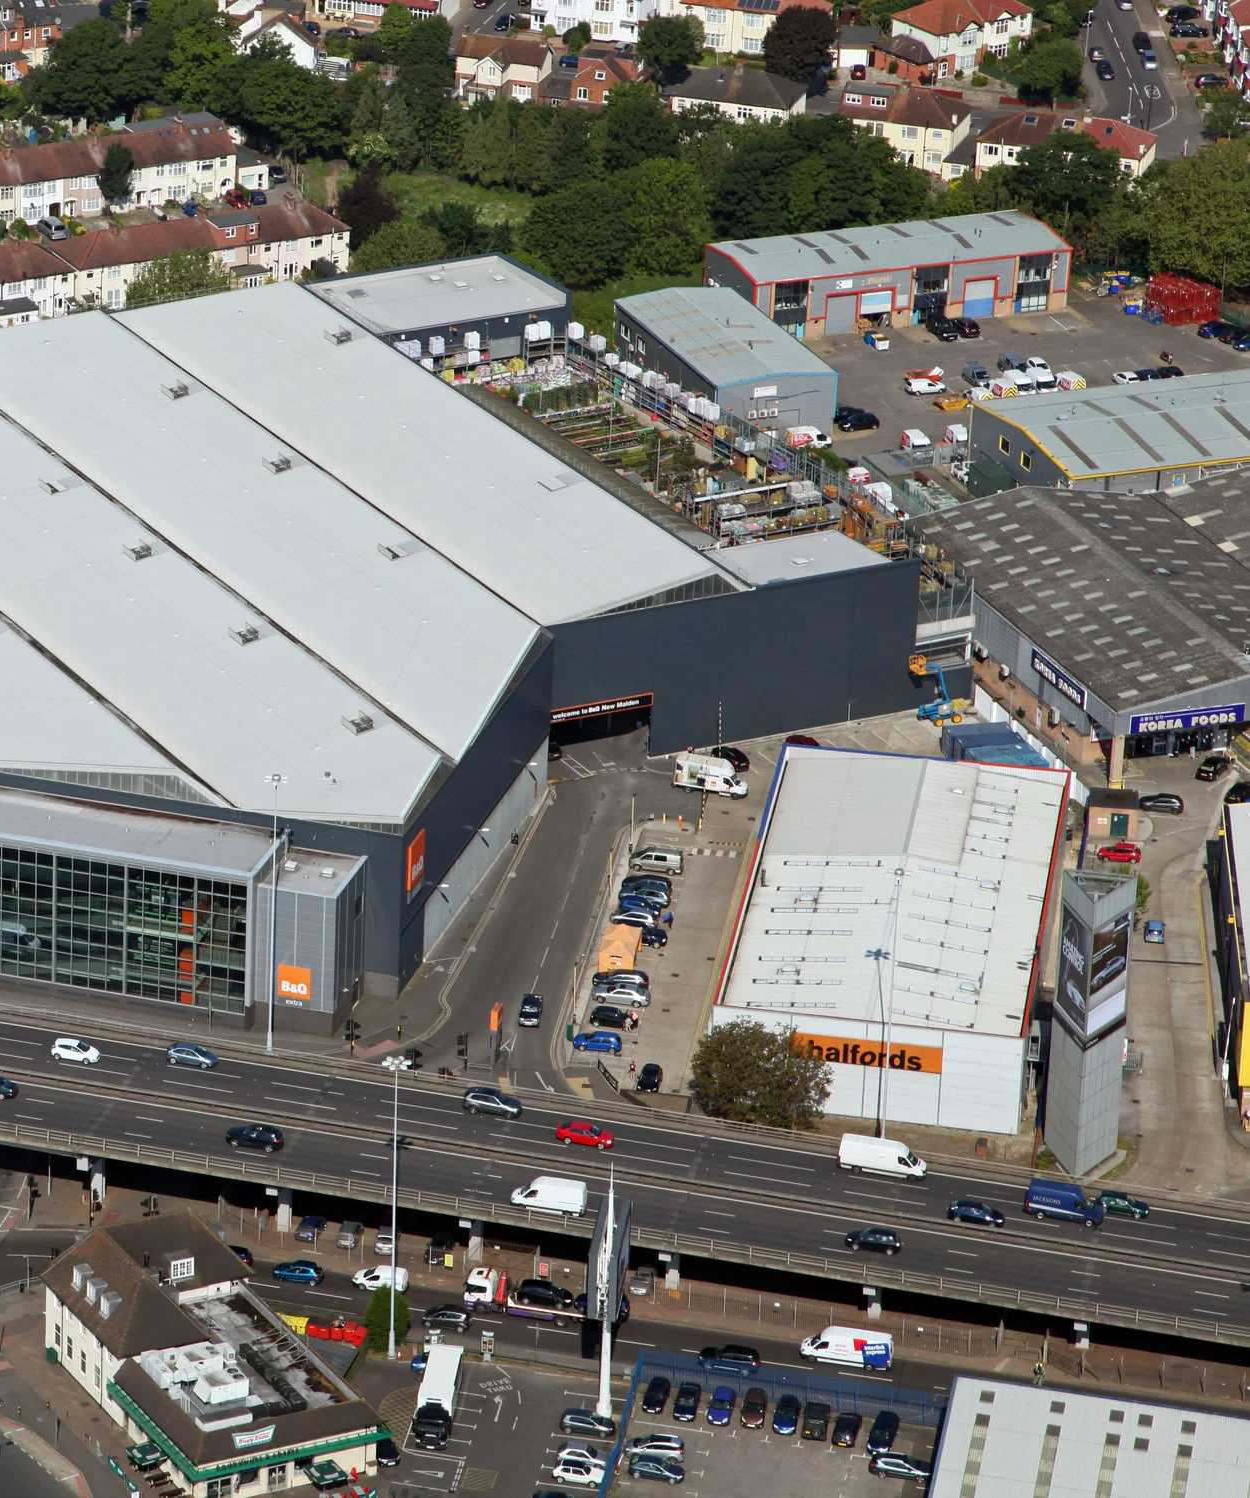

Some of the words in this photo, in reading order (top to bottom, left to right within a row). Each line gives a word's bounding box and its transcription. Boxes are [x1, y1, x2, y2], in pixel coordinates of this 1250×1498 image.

[552, 709, 580, 720] welcome
[601, 703, 615, 711] New
[616, 699, 639, 708] Malden
[1138, 718, 1183, 733] KOREA
[1191, 712, 1236, 727] FOODS
[1063, 936, 1085, 965] AMAZING
[1062, 945, 1084, 975] CONTROL
[281, 979, 308, 995] B&Q
[285, 998, 303, 1007] extra
[807, 1039, 923, 1072] halfords
[1032, 1195, 1062, 1206] JACKSONS
[479, 1377, 511, 1389] DRIVE
[486, 1384, 513, 1394] THRU
